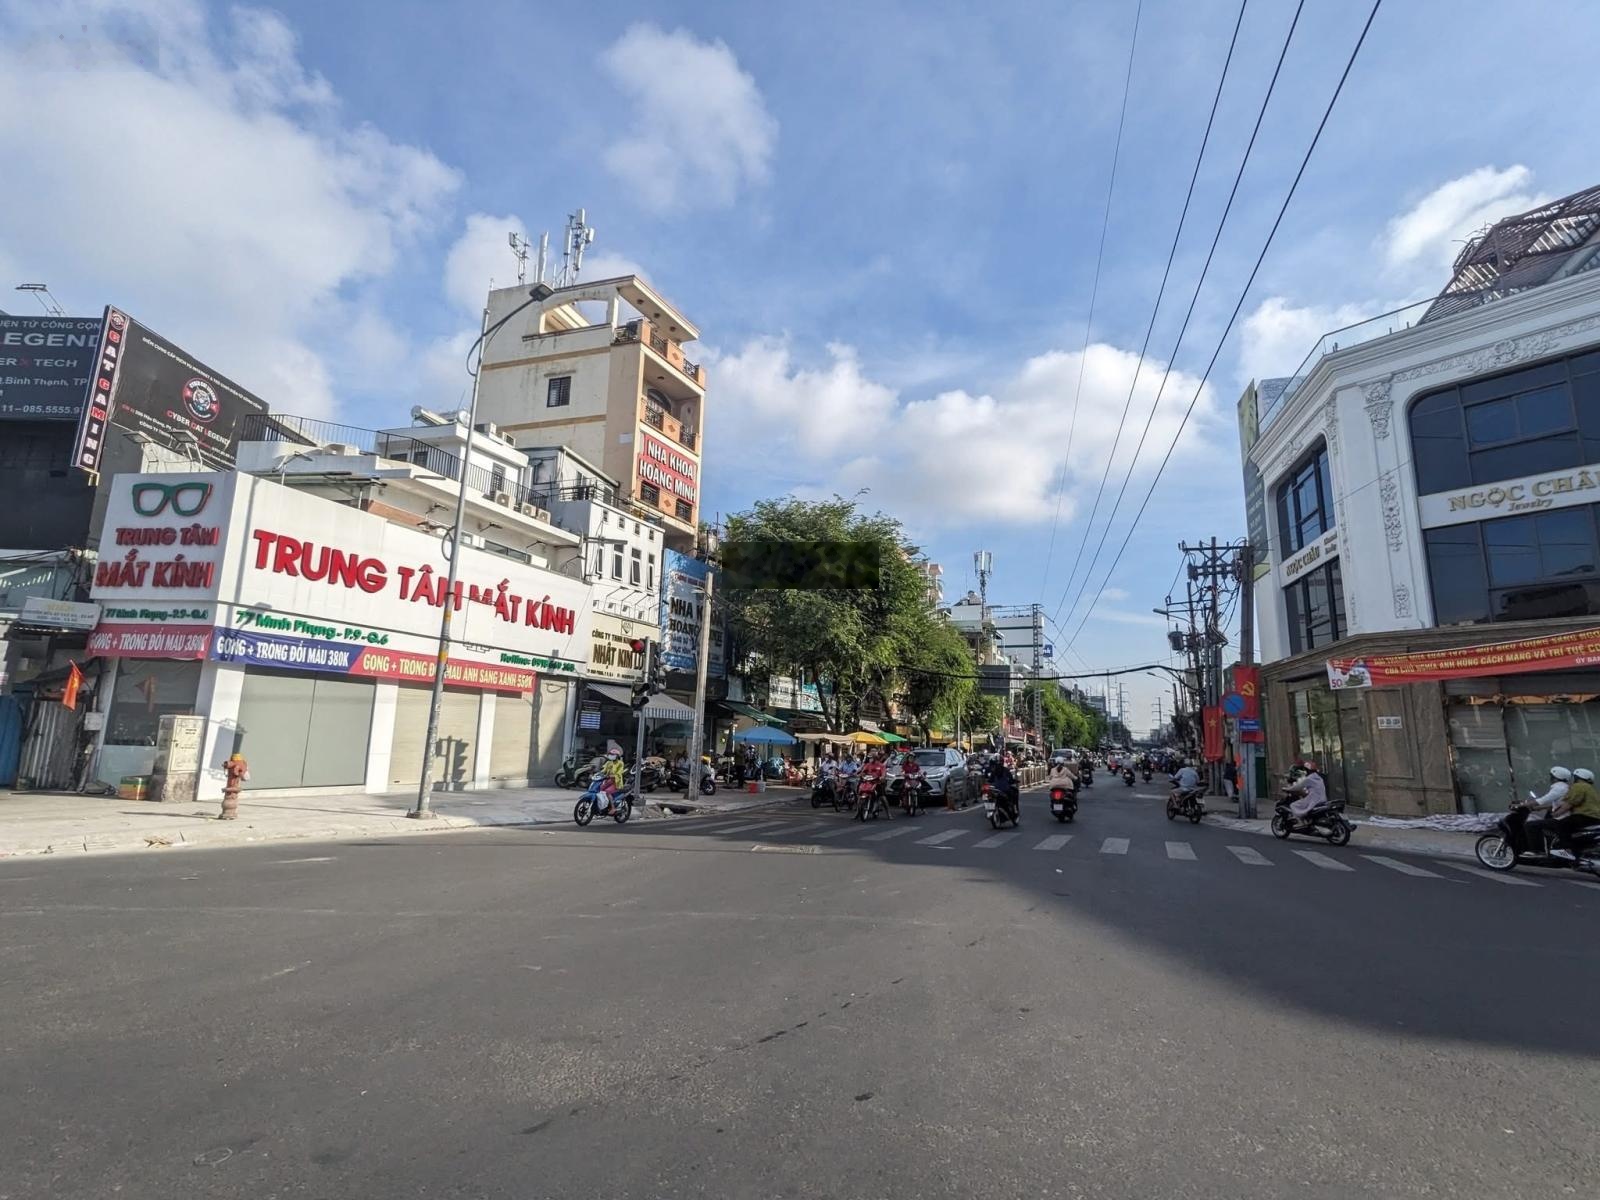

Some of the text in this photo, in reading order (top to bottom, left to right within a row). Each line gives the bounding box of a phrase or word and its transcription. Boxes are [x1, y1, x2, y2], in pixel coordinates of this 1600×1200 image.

[41, 320, 74, 329] CÔNG
[33, 359, 78, 368] TECH
[83, 378, 110, 466] GAMING
[647, 440, 693, 480] NHA KHOA
[639, 458, 696, 503] HOÀNG MINH
[1449, 470, 1600, 512] NGỌC CHÂ
[115, 523, 220, 546] TRUNG TÂM
[95, 548, 215, 588] MẮT KÍNH
[253, 529, 388, 593] TRUNG
[525, 594, 576, 635] KÍNH
[670, 596, 694, 619] NHA
[235, 610, 256, 627] 77
[255, 613, 292, 631] Minh
[293, 619, 336, 640] Phụng
[217, 636, 246, 658] GỌNG
[289, 640, 306, 663] ĐỔI
[328, 650, 350, 667] 380K
[363, 654, 390, 674] GỌNG
[592, 641, 617, 669] NHẬT
[1480, 652, 1504, 665] CÁCH
[1533, 648, 1547, 659] VÀ
[1548, 645, 1564, 657] TRÍ
[1565, 643, 1585, 656] TUỆ
[499, 671, 517, 687] XANH
[1331, 678, 1343, 688] 50
